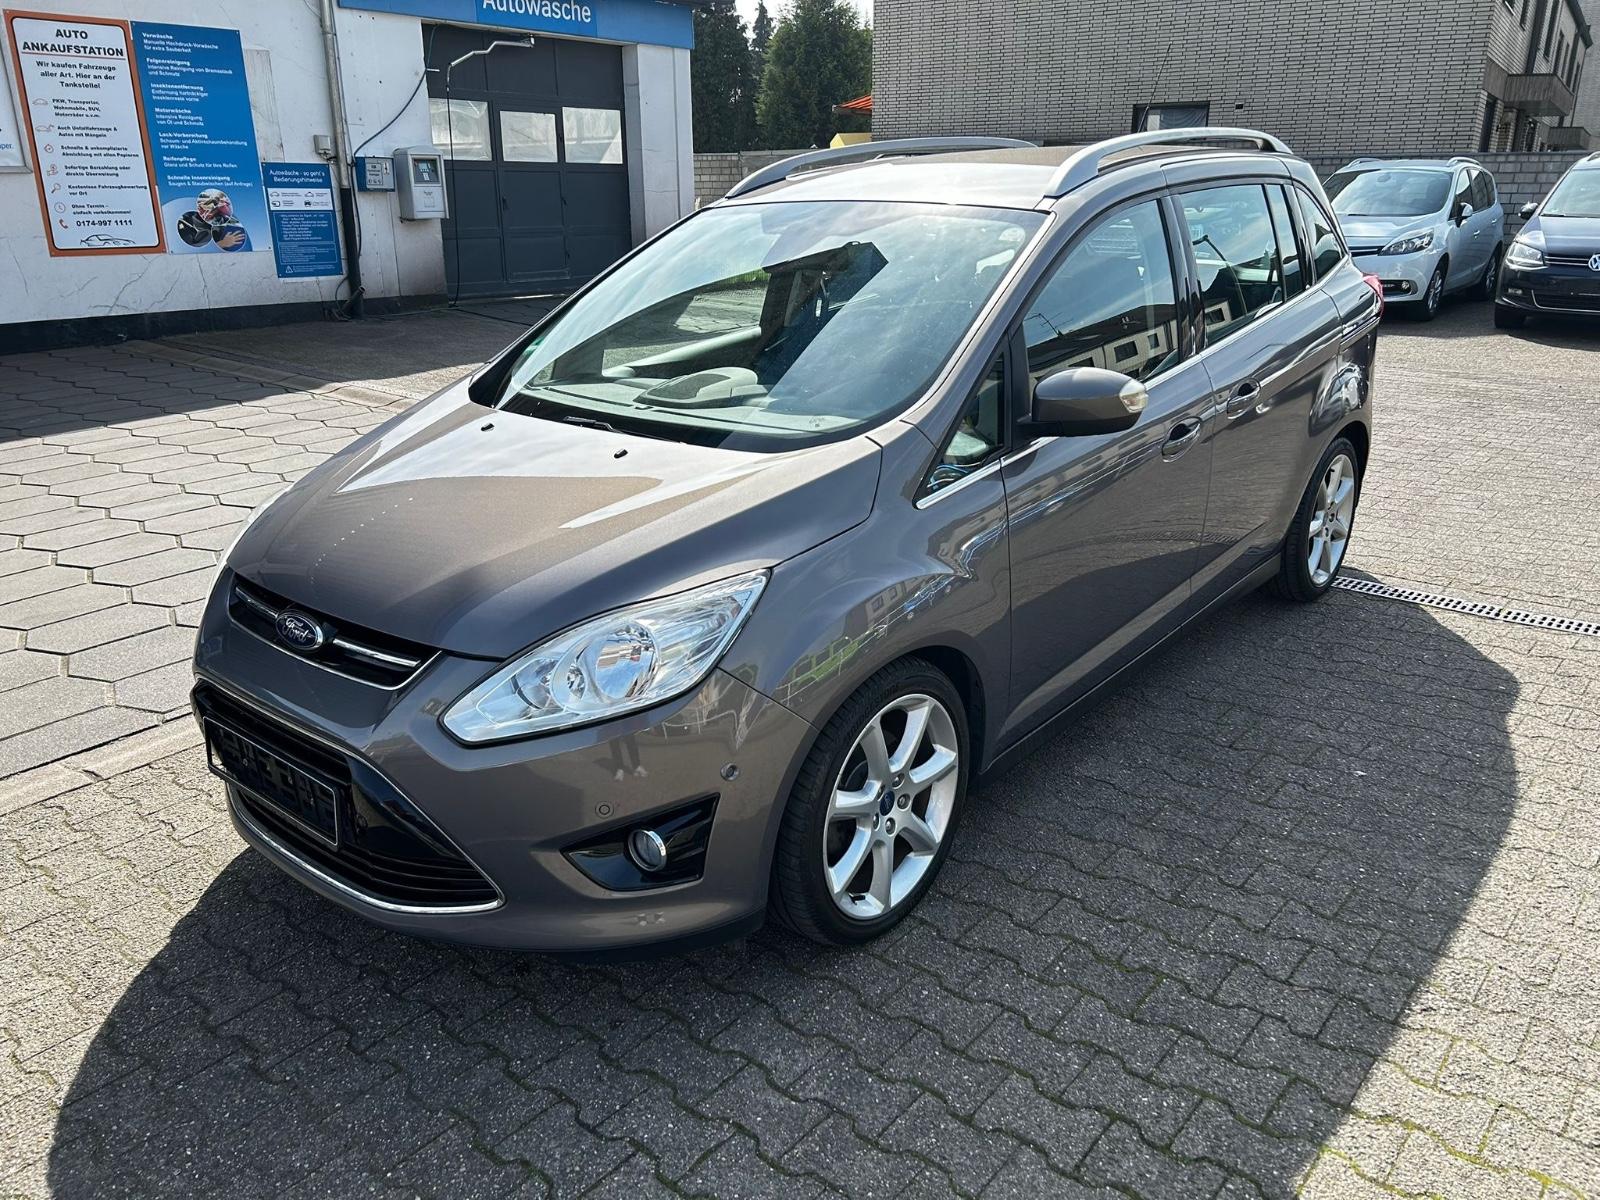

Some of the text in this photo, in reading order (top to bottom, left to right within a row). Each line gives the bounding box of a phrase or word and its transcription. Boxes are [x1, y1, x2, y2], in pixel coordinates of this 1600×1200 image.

[56, 29, 88, 39] AUTO
[22, 42, 123, 56] ANKAUFSTATION
[79, 63, 116, 71] Fahrzeuge
[282, 617, 310, 642] Ford
